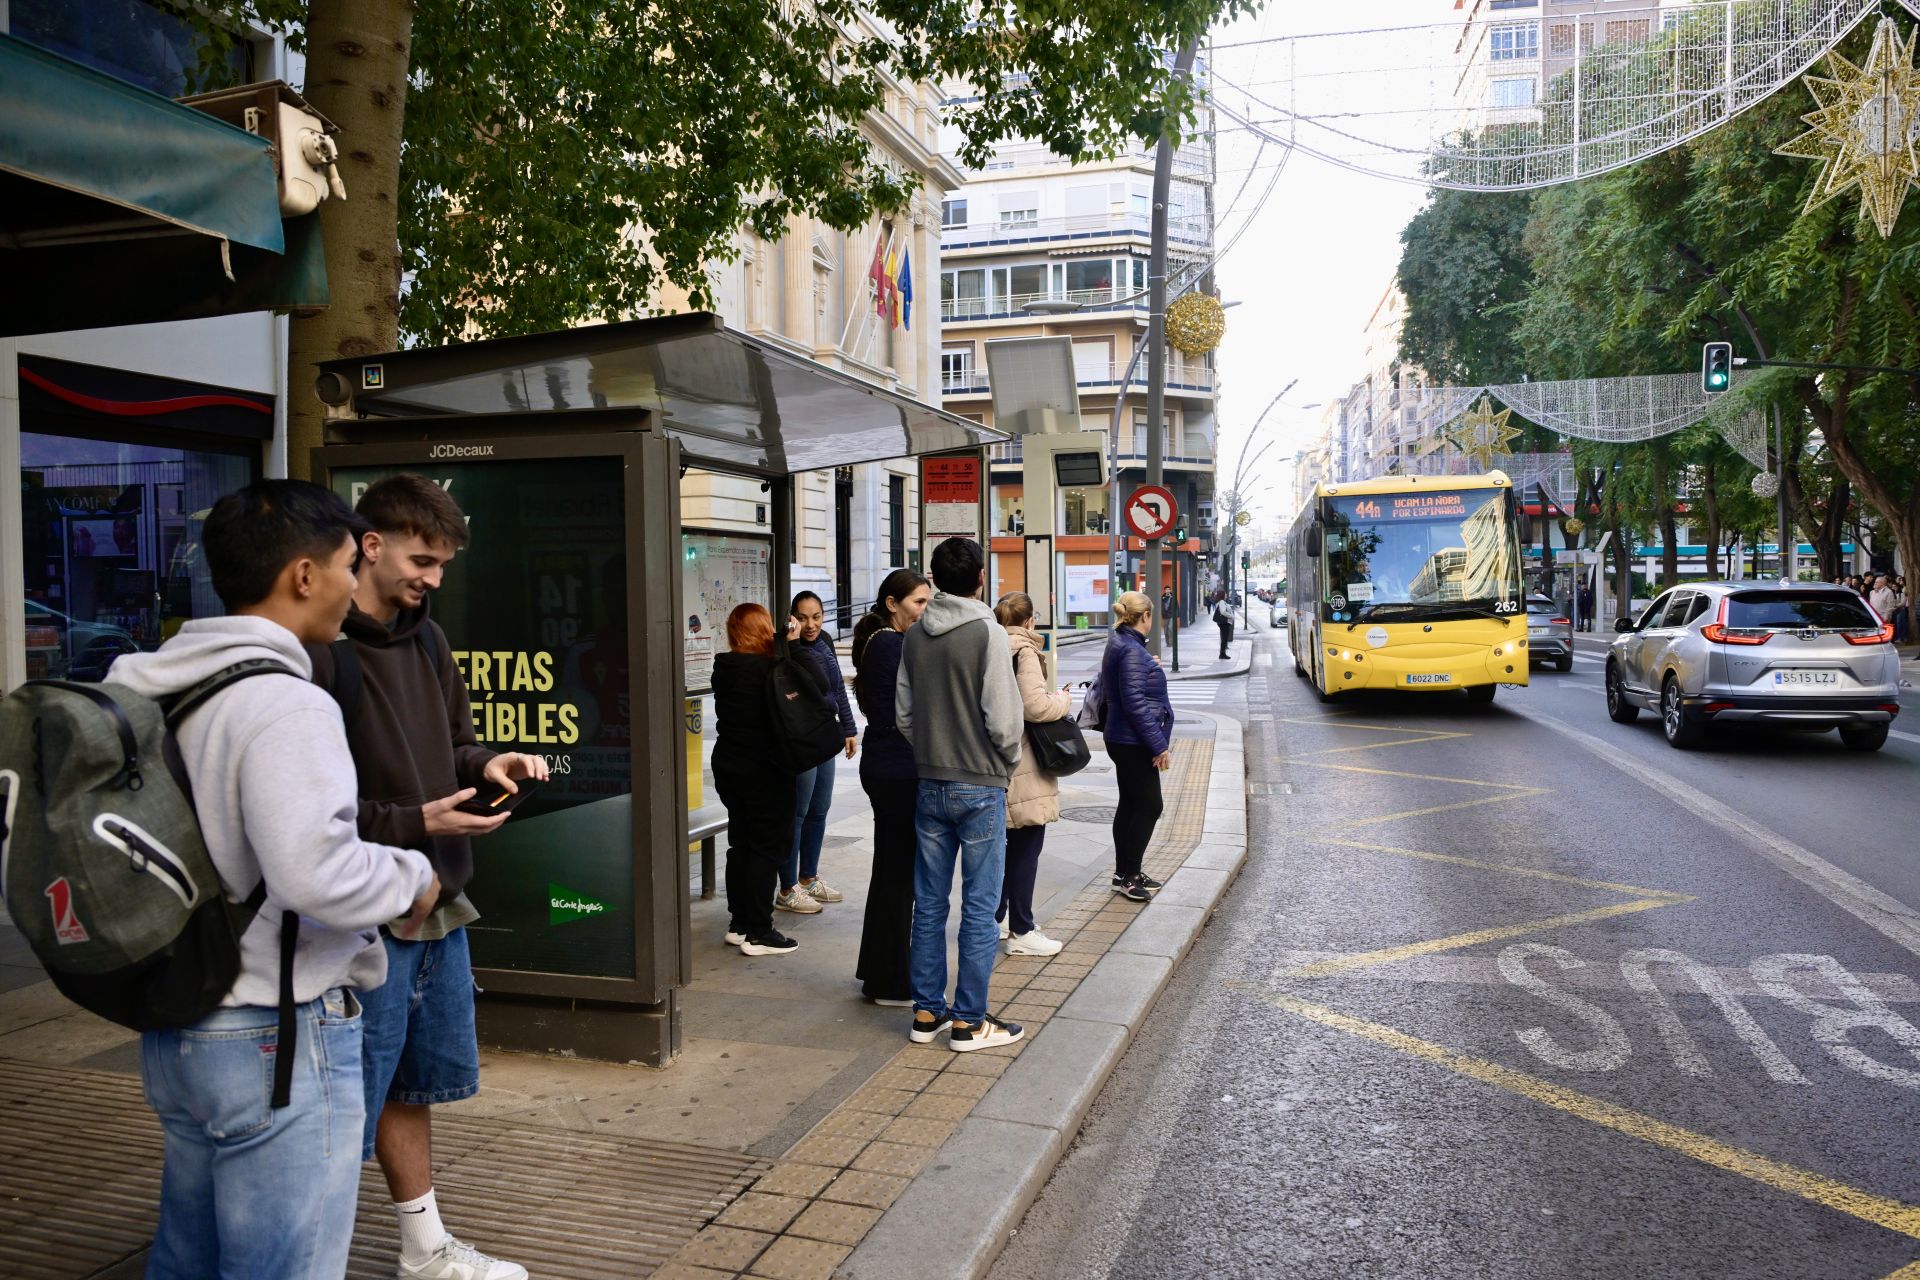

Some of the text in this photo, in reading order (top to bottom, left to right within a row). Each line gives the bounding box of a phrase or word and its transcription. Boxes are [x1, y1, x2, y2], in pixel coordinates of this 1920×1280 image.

[429, 444, 494, 458] JCDecaux
[1394, 495, 1460, 508] UCAM LA ÑORA
[1392, 505, 1466, 517] POR ESPINARDO
[1494, 601, 1518, 613] 262
[451, 651, 554, 692] ERTAS
[1783, 673, 1837, 683] 5515 LZJ
[1412, 674, 1449, 683] 6022 DNC
[470, 692, 579, 745] EÍBLES
[535, 754, 571, 774] CAS
[551, 898, 604, 913] El Corte Inglés
